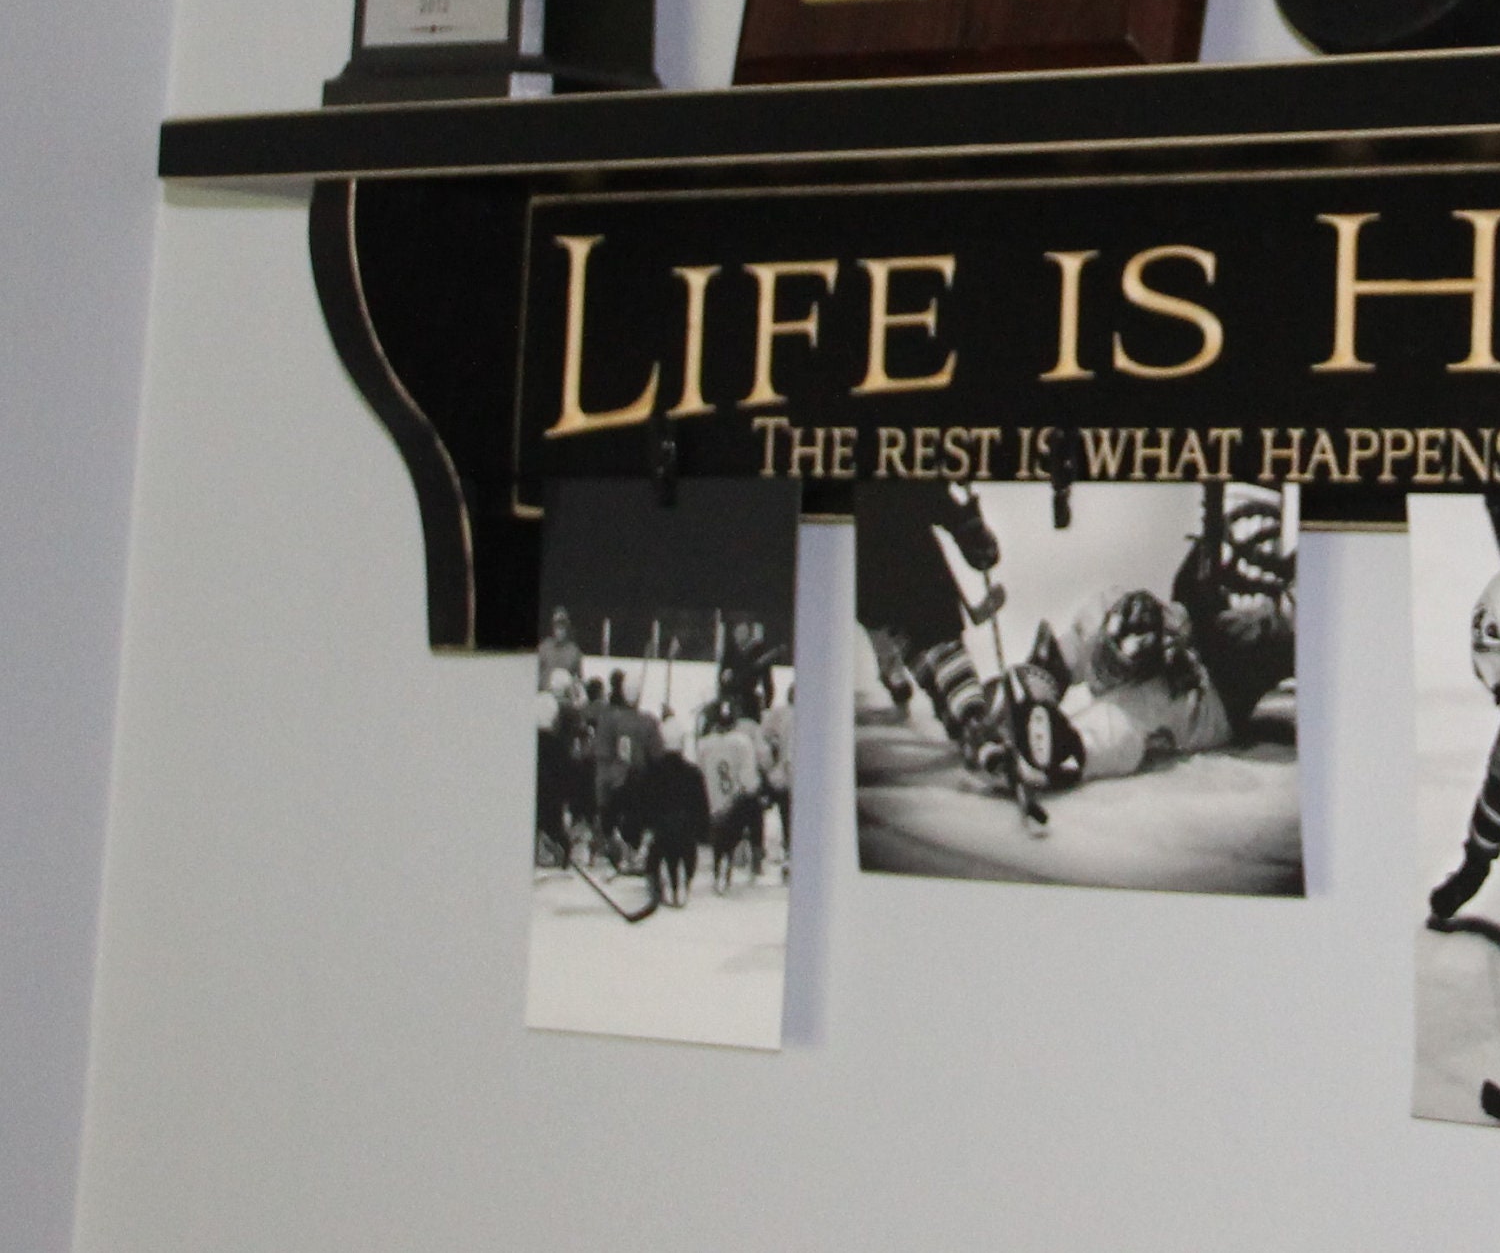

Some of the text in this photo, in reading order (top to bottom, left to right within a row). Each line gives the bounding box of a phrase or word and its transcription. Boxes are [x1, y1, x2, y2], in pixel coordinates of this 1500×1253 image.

[544, 233, 957, 439] LIFE
[1038, 245, 1225, 382] IS
[752, 416, 858, 479] THE
[873, 426, 1001, 480] REST
[1079, 427, 1243, 482] WHAT
